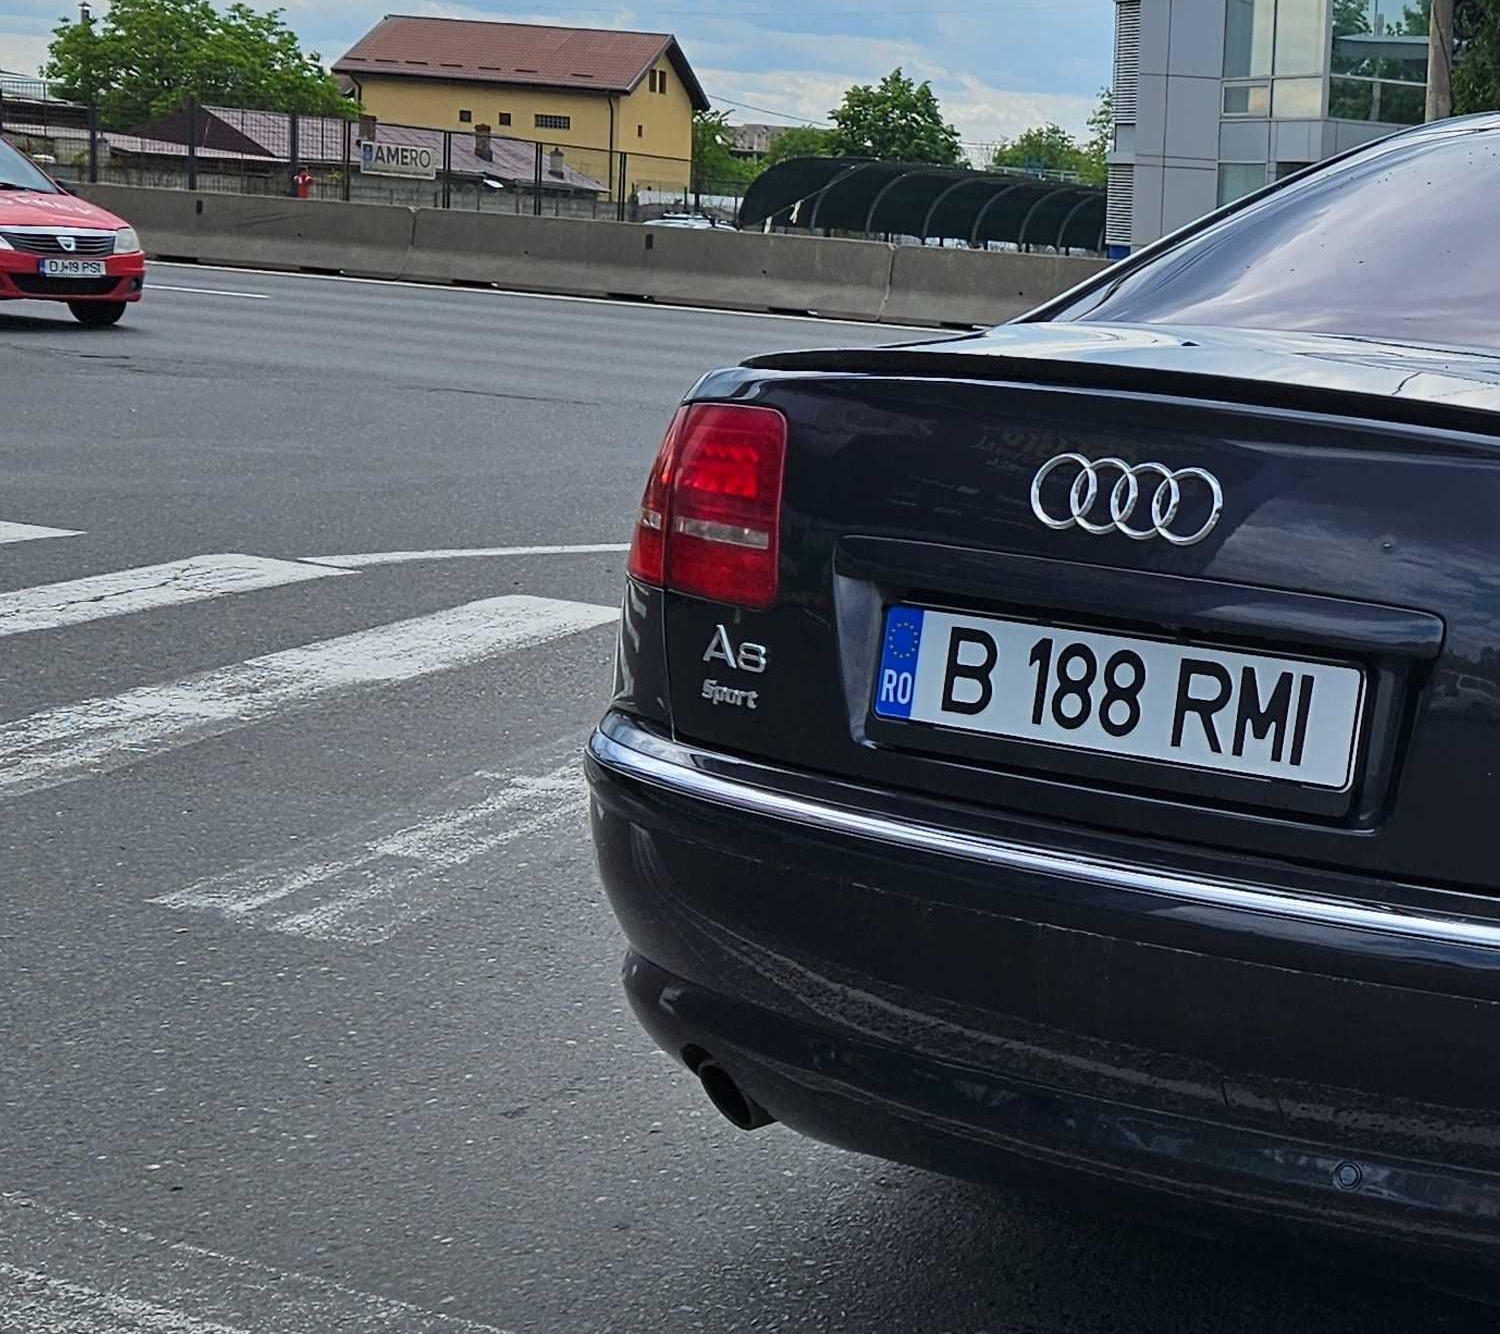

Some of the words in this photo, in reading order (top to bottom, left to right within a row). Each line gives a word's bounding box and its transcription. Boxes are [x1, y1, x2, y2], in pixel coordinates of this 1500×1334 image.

[374, 145, 432, 169] AMERO
[702, 623, 767, 674] A8
[701, 678, 760, 710] Sport
[880, 668, 913, 706] RO
[940, 625, 999, 716] B
[1028, 637, 1147, 738] 188
[1170, 657, 1315, 767] RMI
